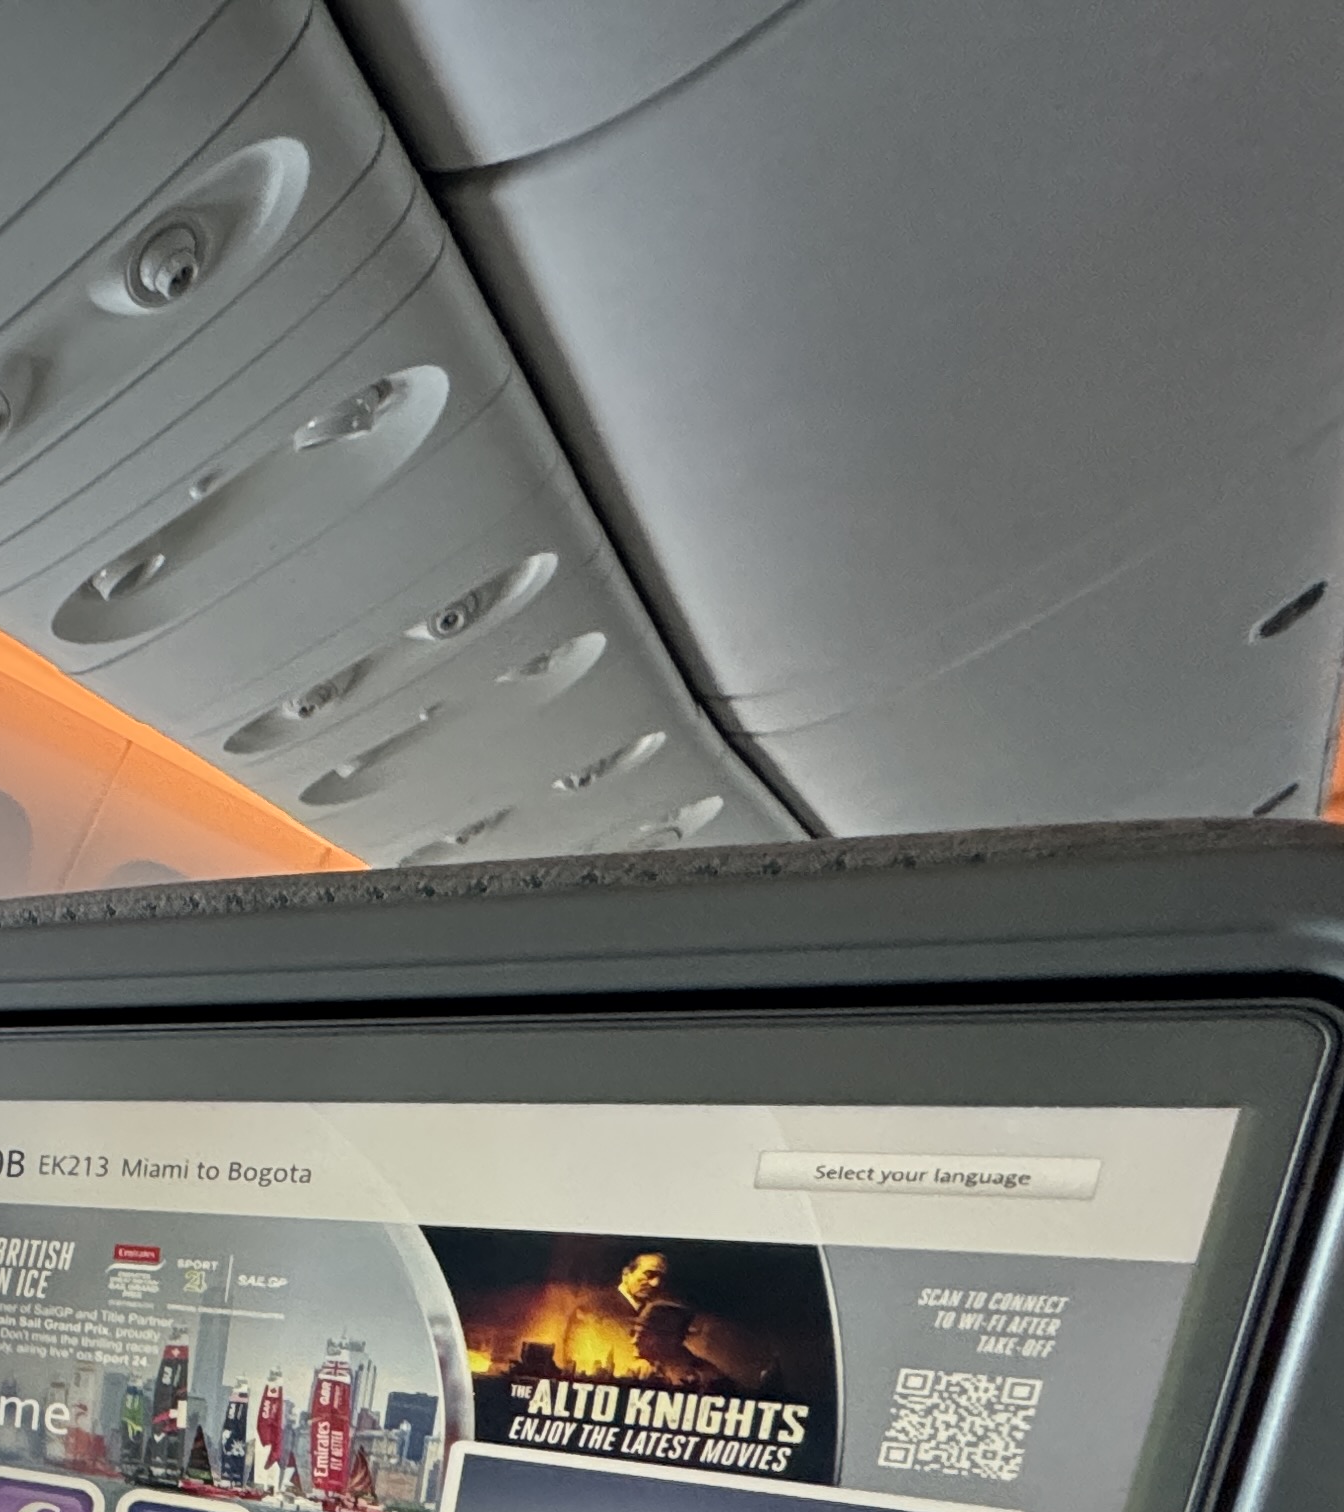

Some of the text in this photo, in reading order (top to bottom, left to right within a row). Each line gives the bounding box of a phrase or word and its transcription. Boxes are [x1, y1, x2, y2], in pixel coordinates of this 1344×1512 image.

[38, 1155, 109, 1178] EK213
[122, 1158, 189, 1182] Miami
[197, 1161, 220, 1182] to
[228, 1161, 313, 1186] Bogota
[814, 1164, 1032, 1188] Select your language
[15, 1268, 52, 1299] ICE
[917, 1287, 1070, 1314] SCAN TO CONNECT
[933, 1310, 1061, 1337] TO WI-FI AFTER
[976, 1335, 1056, 1359] TAKE-OFF
[511, 1378, 810, 1445] THE ALTO KNIGHTS
[313, 1420, 331, 1478] Emirates
[508, 1415, 793, 1473] ENJOY THE LATEST MOVIES
